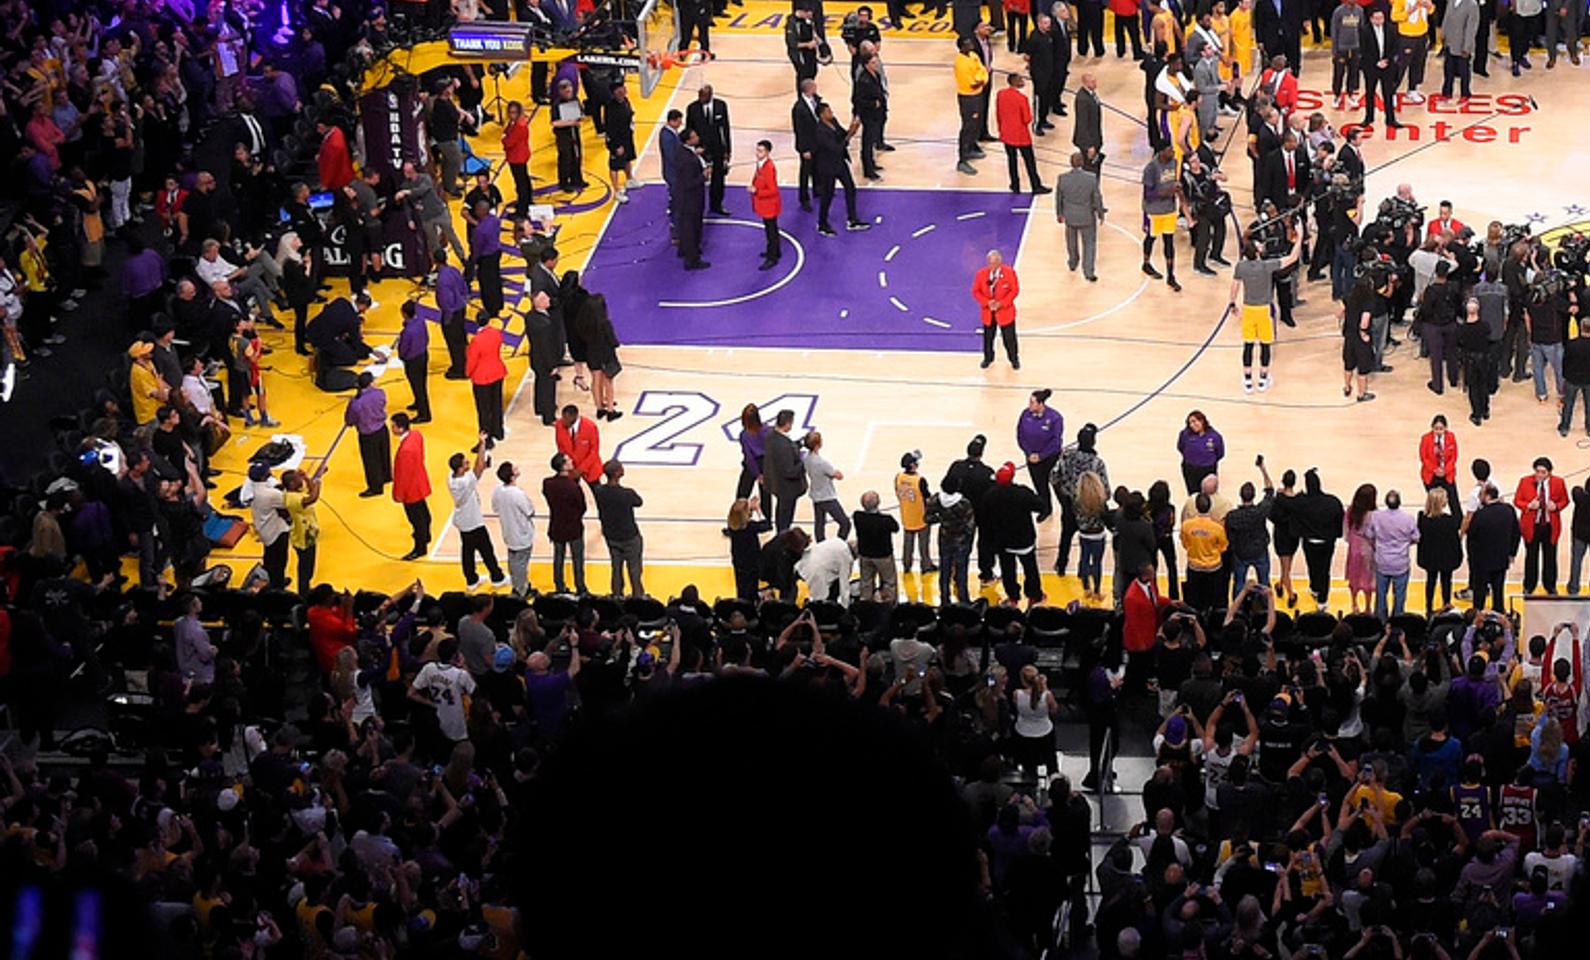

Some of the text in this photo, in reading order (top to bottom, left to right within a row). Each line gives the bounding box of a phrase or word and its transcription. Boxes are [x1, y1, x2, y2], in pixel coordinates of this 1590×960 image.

[453, 38, 482, 51] THANK
[484, 38, 502, 51] YOU
[1339, 120, 1533, 144] enter
[1460, 804, 1483, 819] 24
[1502, 806, 1533, 825] 33
